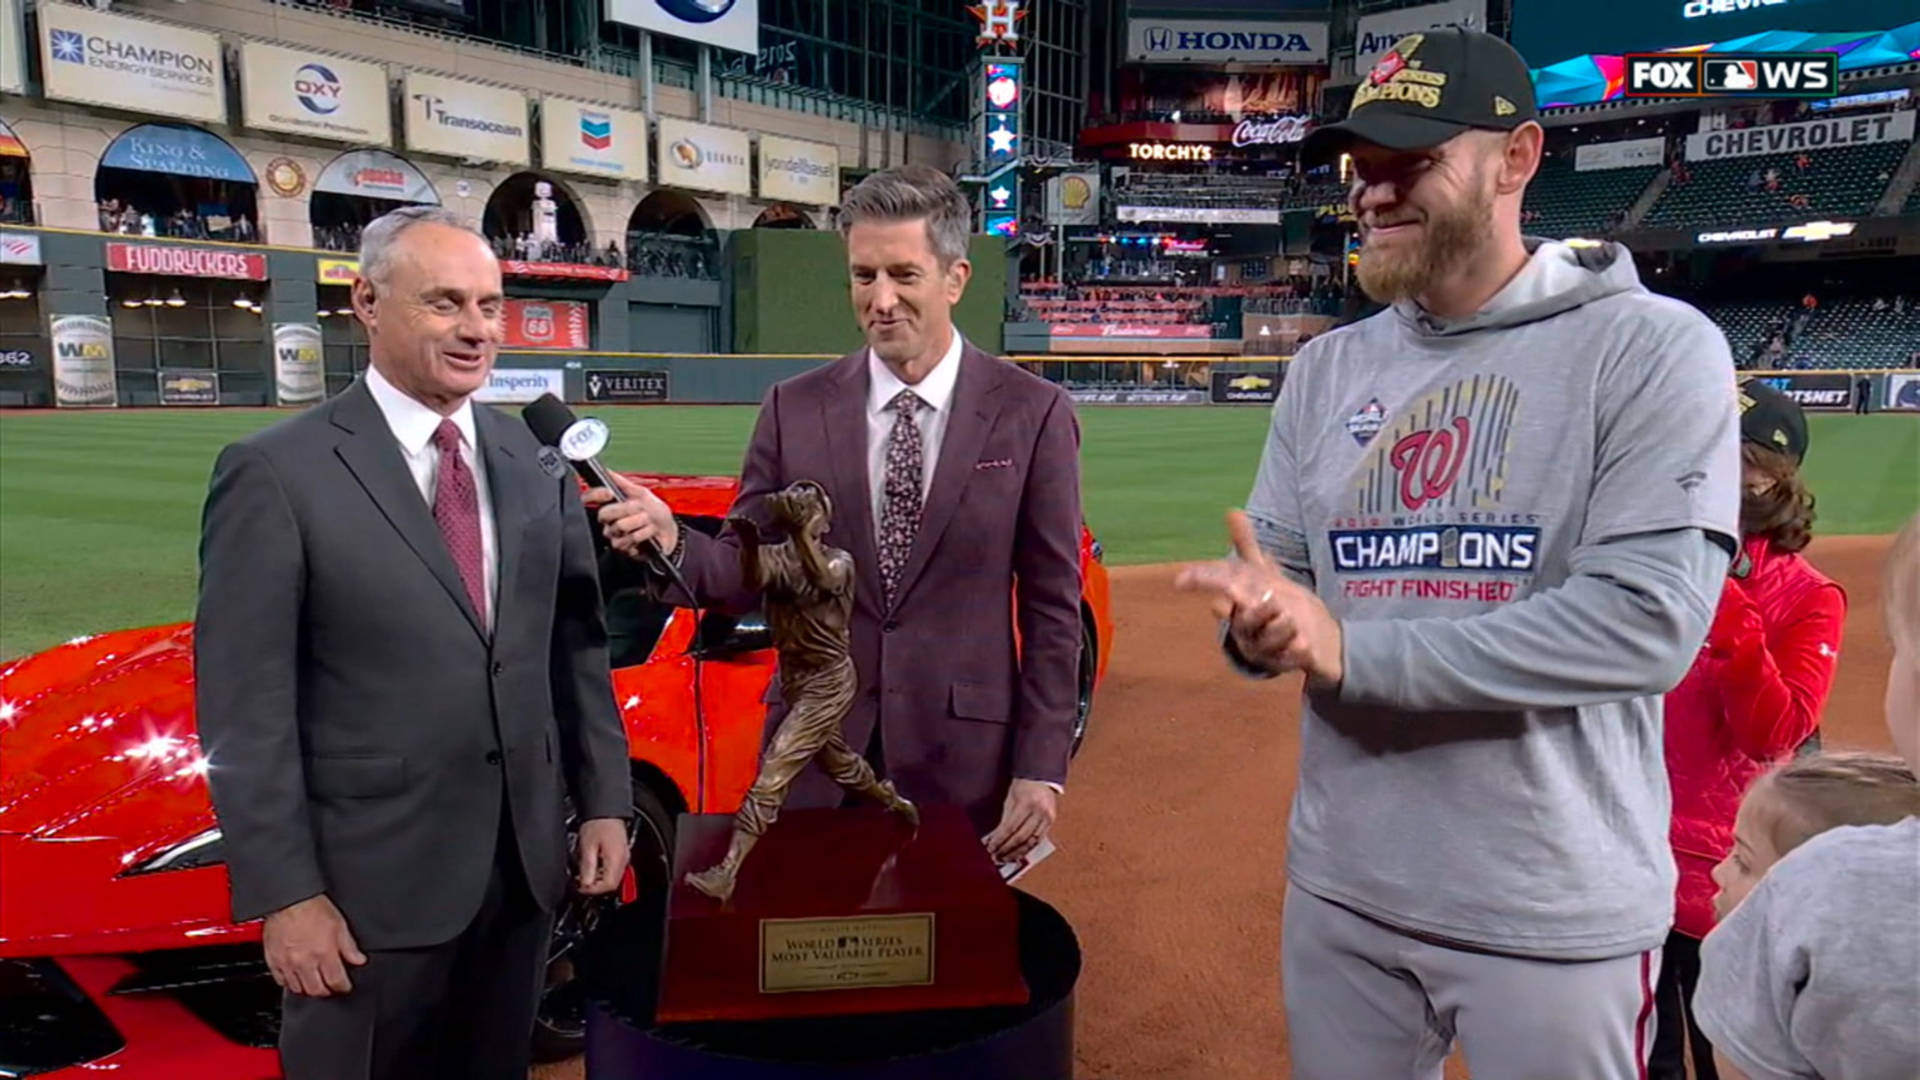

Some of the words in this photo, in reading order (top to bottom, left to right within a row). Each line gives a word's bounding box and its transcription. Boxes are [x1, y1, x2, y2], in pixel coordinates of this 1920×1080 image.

[1177, 31, 1312, 52] HONDA
[86, 36, 214, 75] CHAMPION
[88, 57, 149, 76] ENERGY
[149, 66, 215, 88] SERVICES
[294, 80, 342, 99] OXY
[434, 109, 523, 137] Transocean
[1706, 116, 1893, 157] CHEVROLET
[189, 144, 207, 161] &
[1697, 227, 1778, 243] CHEVROLET
[126, 245, 250, 279] FUDDRUCKERS
[527, 319, 549, 334] 66
[58, 342, 107, 358] WM
[279, 347, 319, 363] WM
[488, 373, 550, 390] Insperity
[604, 377, 666, 391] VERITEX
[568, 425, 595, 449] FOX
[1389, 416, 1472, 511] W
[1393, 513, 1445, 527] WORLD
[1458, 512, 1539, 525] SERIES
[1345, 580, 1396, 598] FIGHT
[1401, 580, 1513, 601] FINISHED
[785, 937, 835, 951] WORLD
[861, 935, 903, 947] SERIES
[771, 952, 809, 963] MOST
[812, 948, 873, 961] VALUABLE
[878, 945, 924, 958] PLAYER
